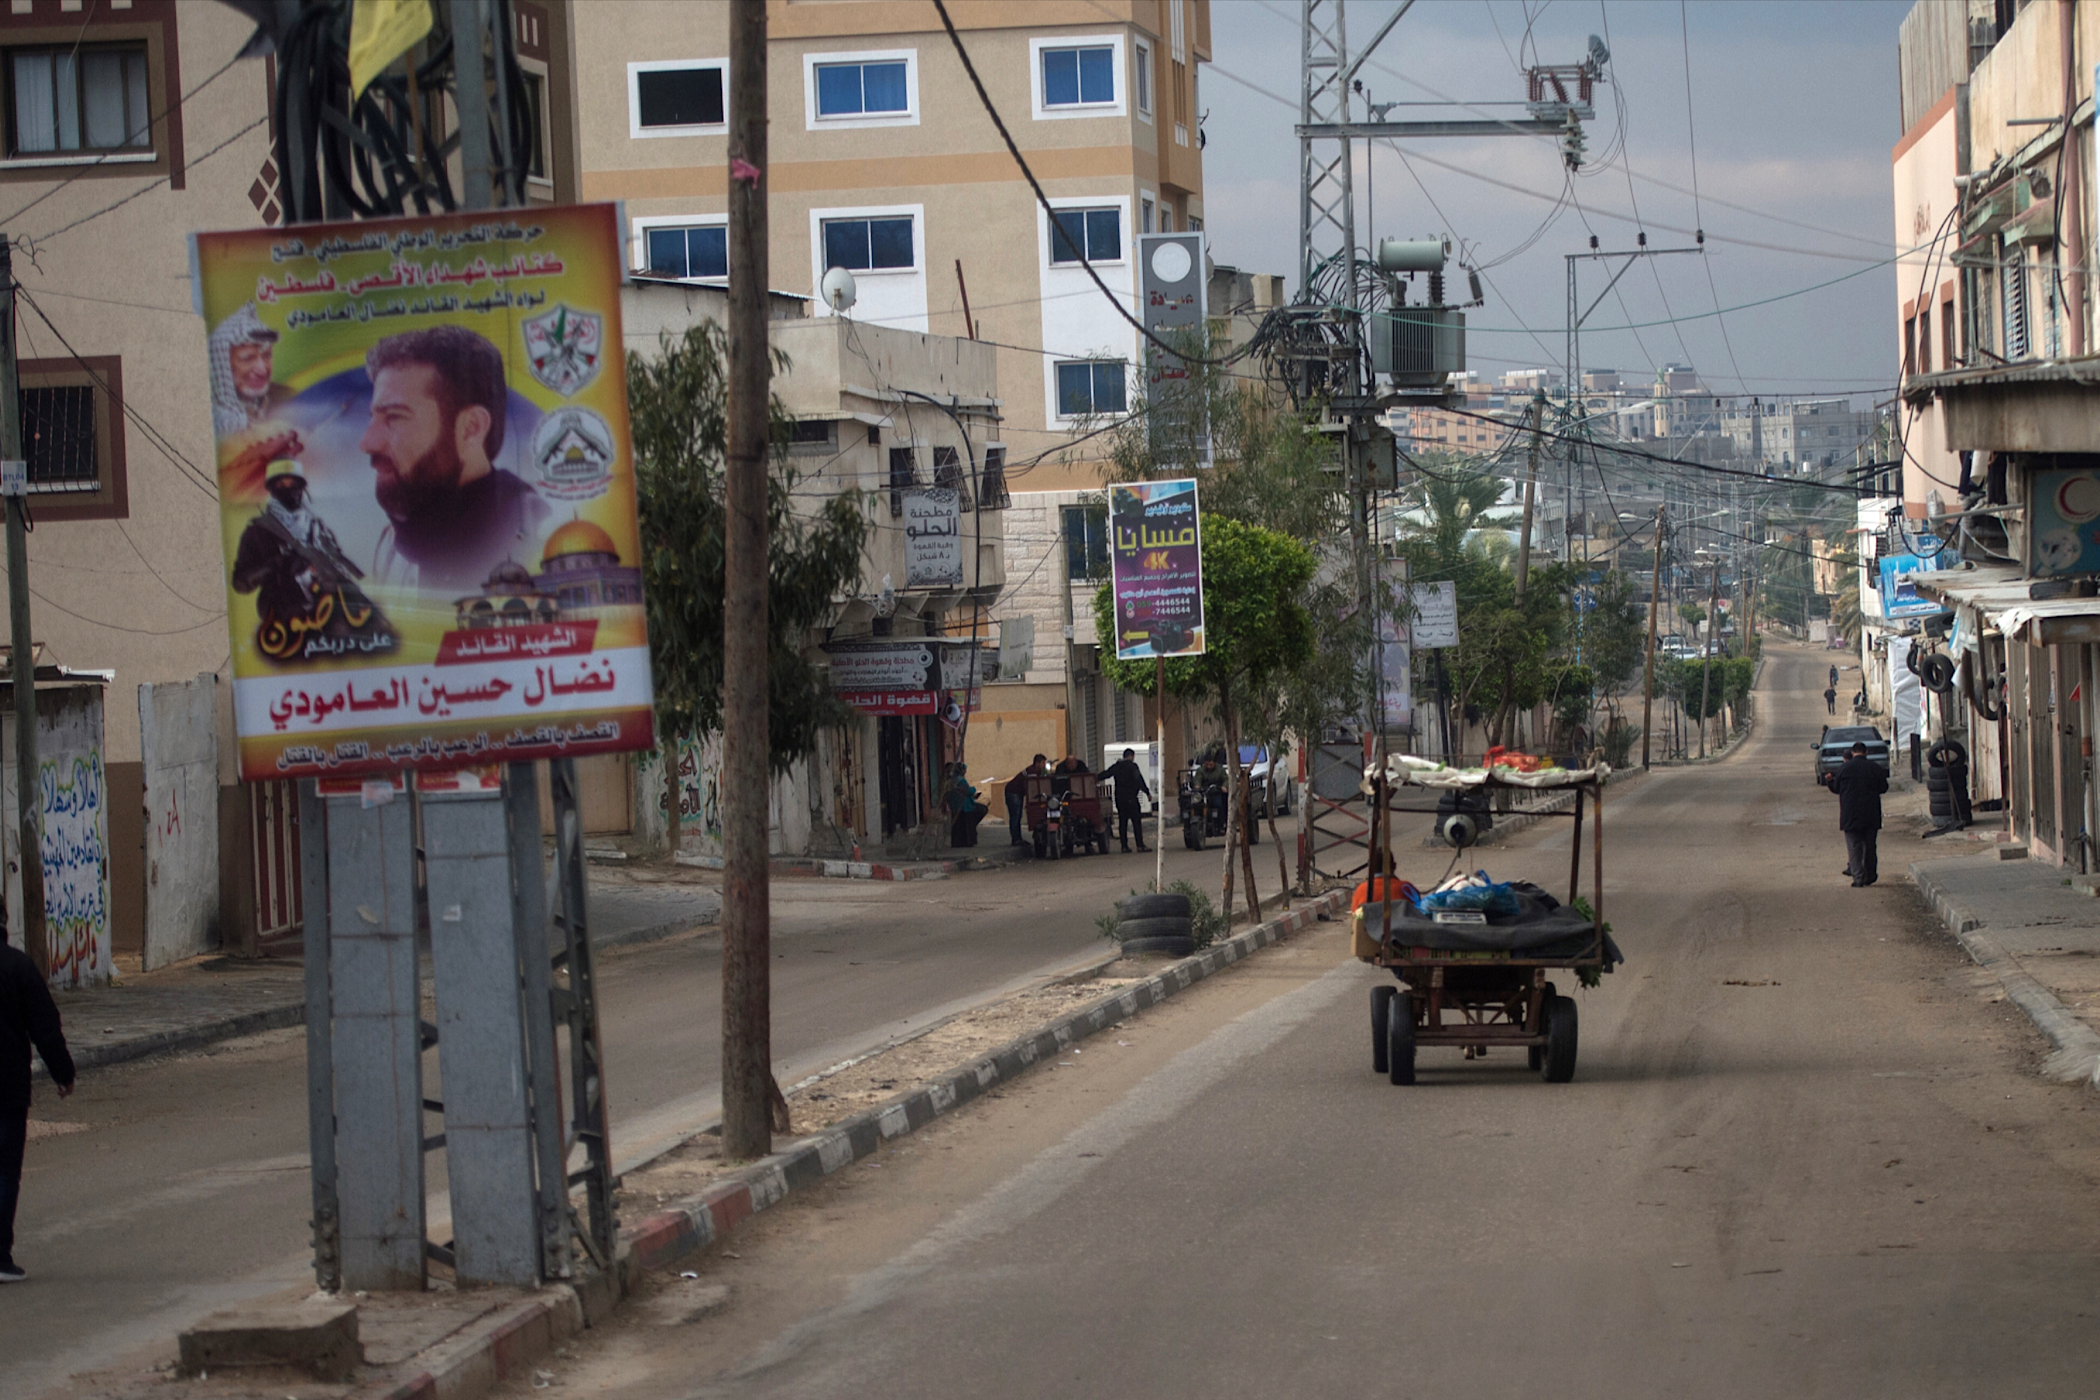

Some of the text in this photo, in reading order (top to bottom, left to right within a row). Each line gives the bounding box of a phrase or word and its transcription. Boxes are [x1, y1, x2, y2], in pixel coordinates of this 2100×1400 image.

[314, 232, 388, 263] الفلسطيني
[439, 224, 491, 249] التحرير
[426, 256, 487, 287] شهداء
[491, 253, 565, 284] كتائب
[257, 271, 335, 303] فلسطين
[463, 289, 513, 313] الشهيد
[910, 505, 952, 518] مطحنة
[907, 517, 957, 542] الحلو
[1143, 551, 1170, 570] 4K
[305, 631, 392, 658] على دربكم
[456, 626, 576, 656] الشهيد القائد
[269, 658, 615, 731] نضال حسين العامودي
[887, 693, 931, 707] قهوة
[443, 732, 488, 757] الرعب
[505, 726, 566, 748] بالقصف
[568, 722, 620, 743] القصف
[277, 744, 326, 770] بالقتل
[328, 741, 369, 766] القتل
[386, 736, 440, 762] بالرعب
